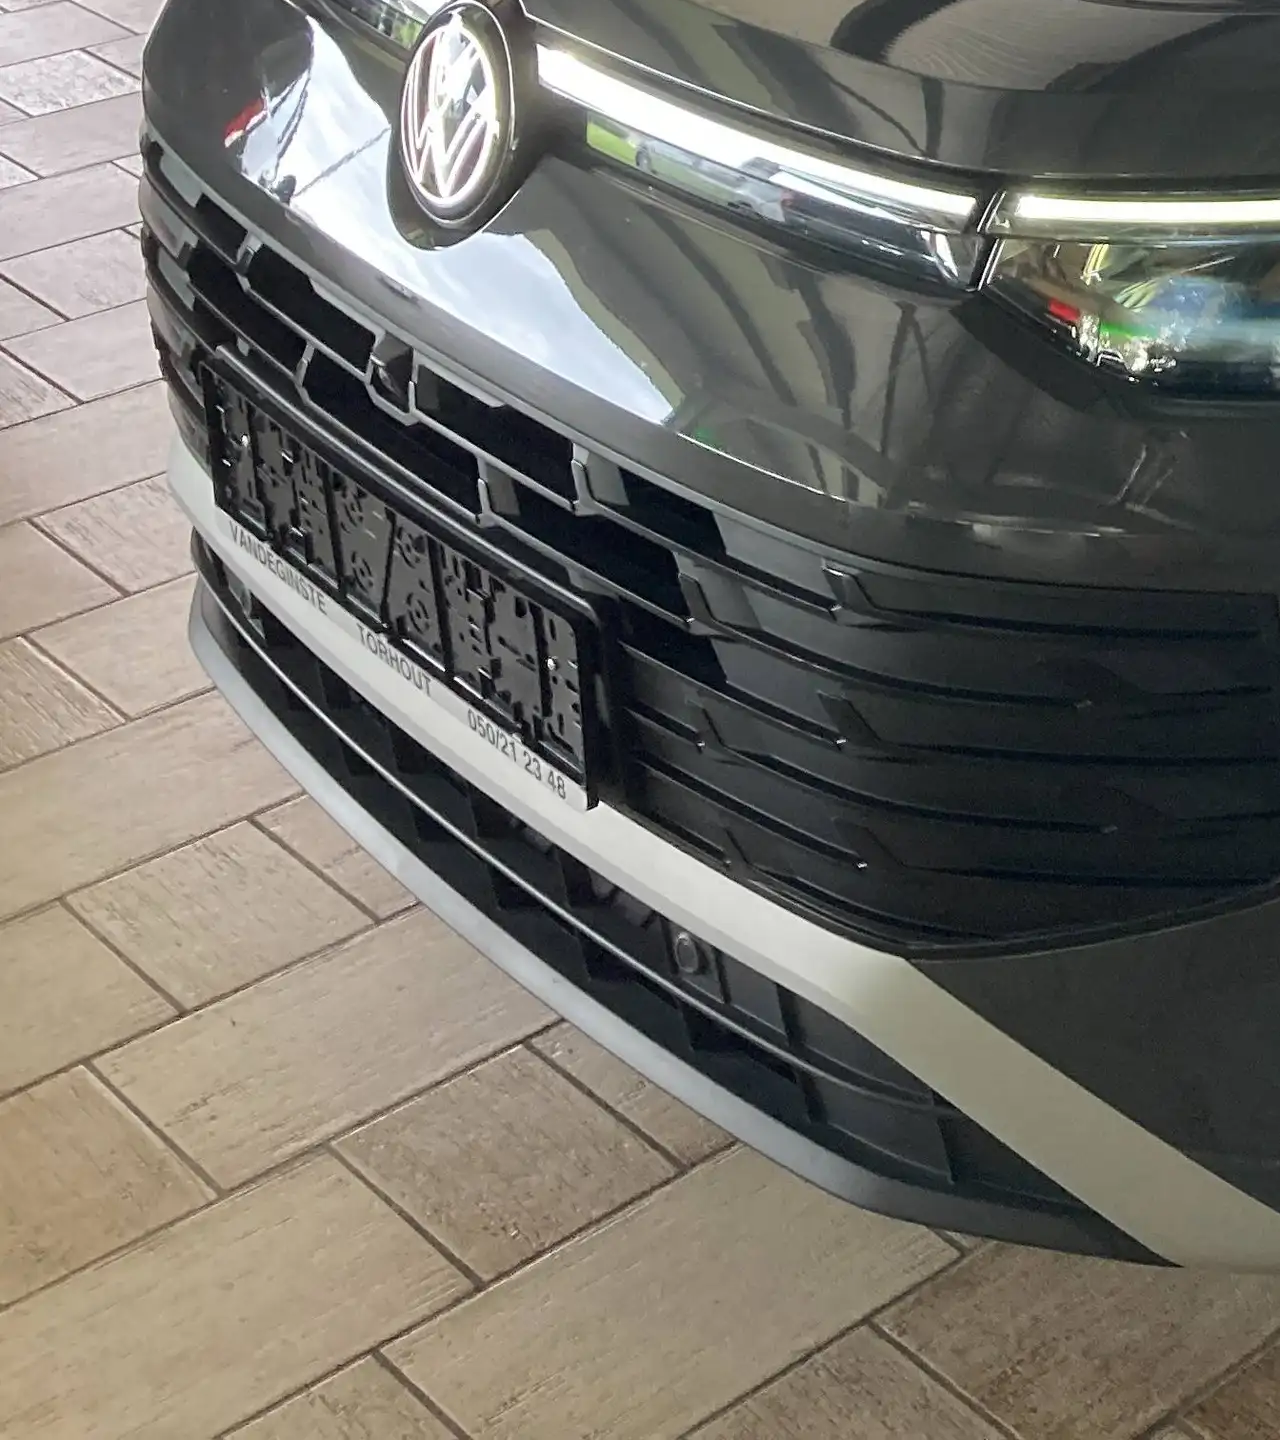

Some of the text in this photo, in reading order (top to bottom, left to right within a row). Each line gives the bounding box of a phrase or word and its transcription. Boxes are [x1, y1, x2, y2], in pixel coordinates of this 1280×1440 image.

[229, 519, 566, 800] VANDEGINSTE TORHOUT 050/21 23 48
